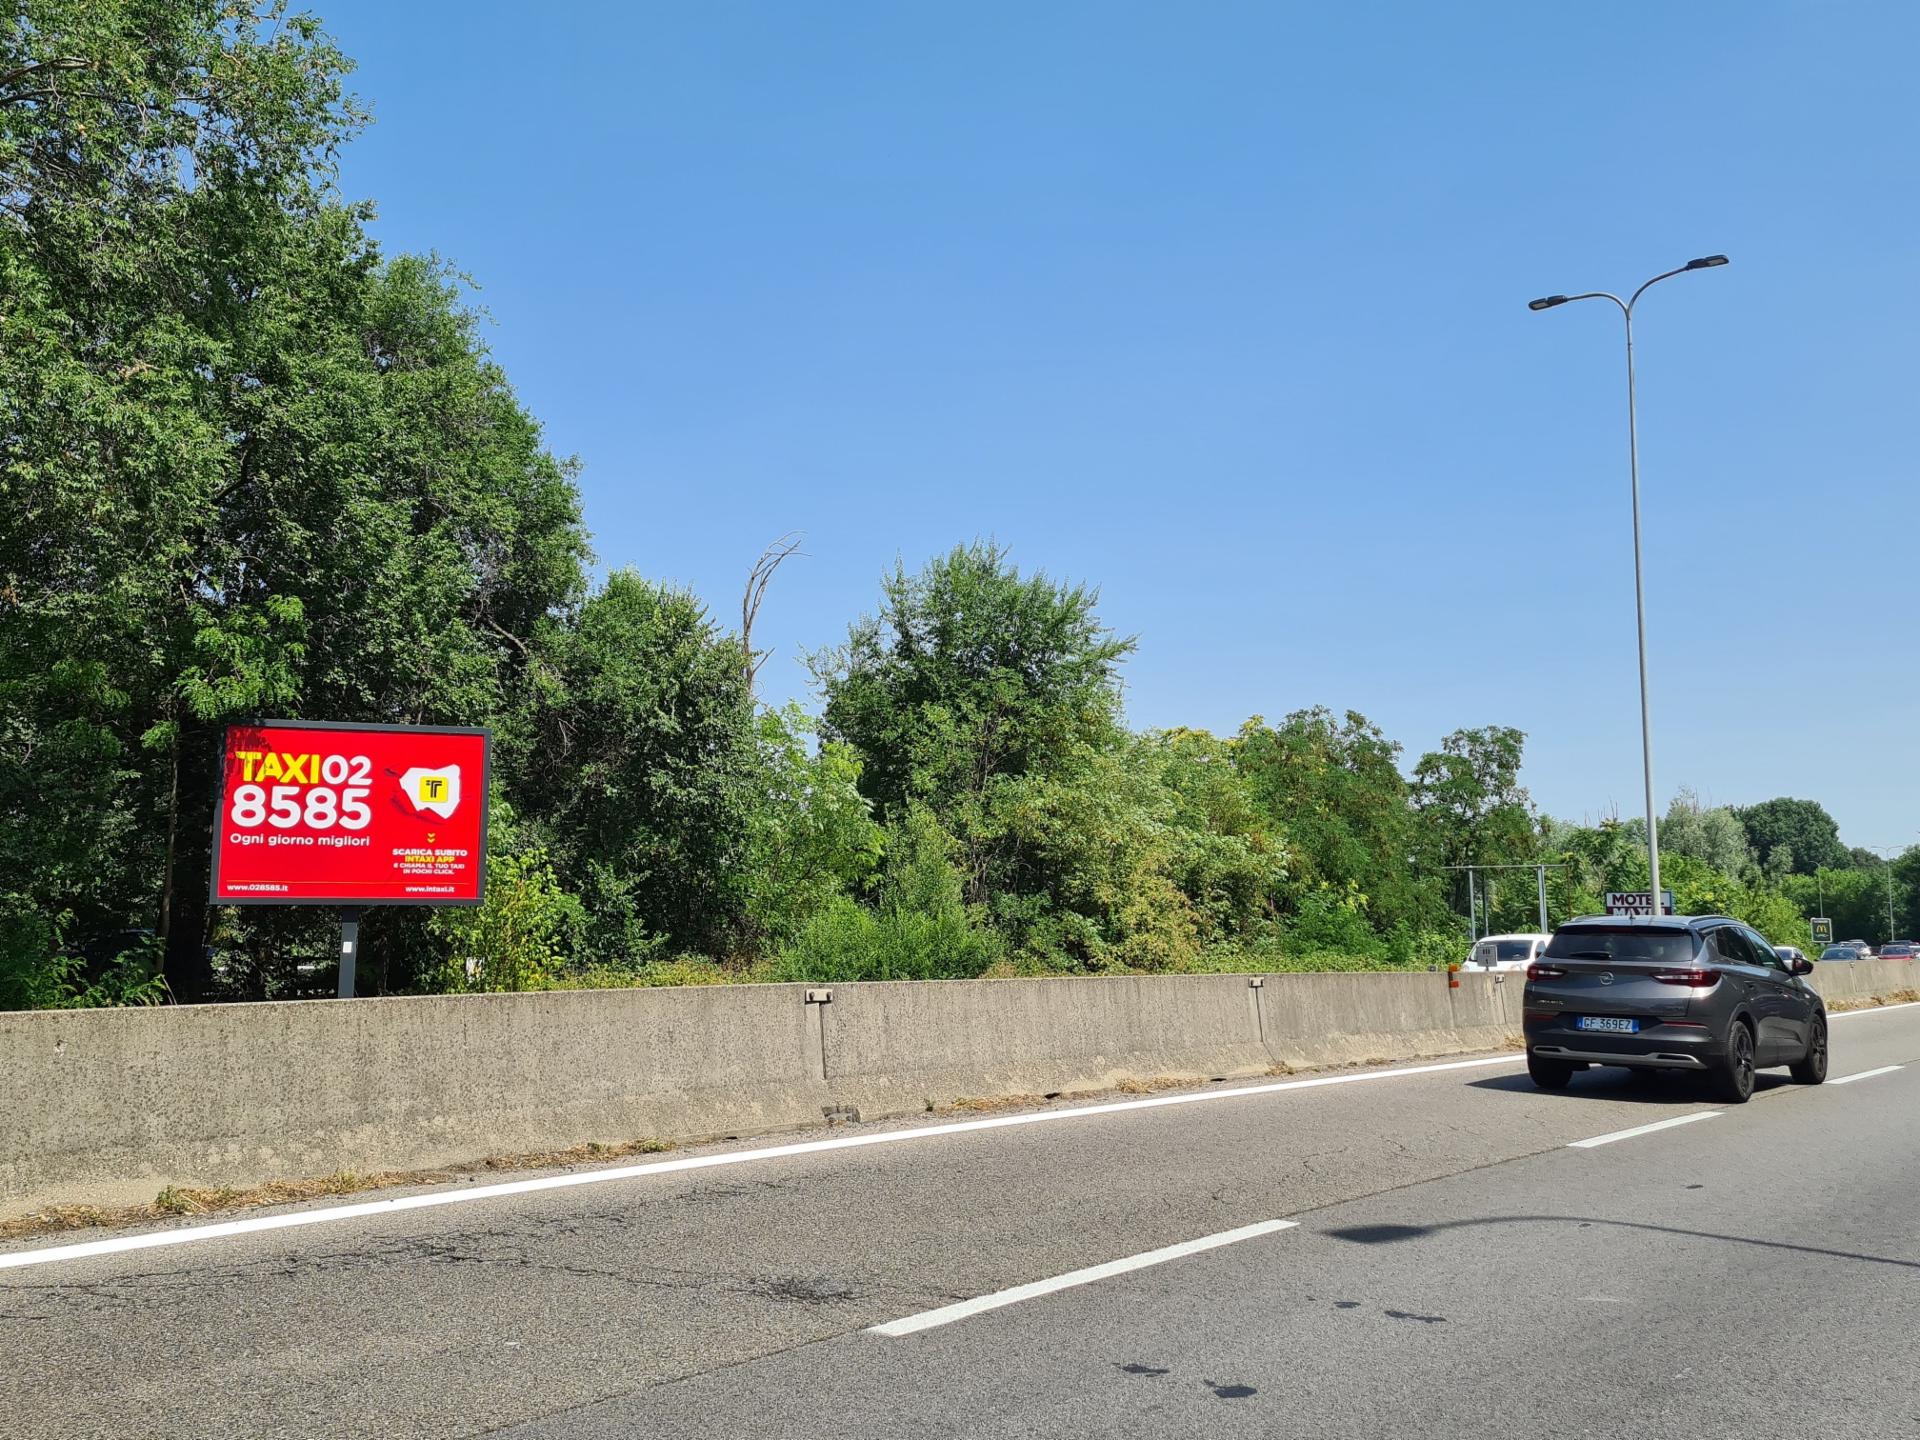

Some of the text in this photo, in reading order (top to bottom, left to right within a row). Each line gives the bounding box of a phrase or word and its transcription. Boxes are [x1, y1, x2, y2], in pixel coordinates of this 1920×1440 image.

[230, 784, 372, 830] 8585
[229, 832, 371, 848] Ogni giorno migliori
[392, 848, 468, 857] SCARICA SUBITO
[404, 855, 456, 863] INTAXI APP
[226, 882, 289, 892] www.028585.it
[1612, 893, 1665, 906] MOTE
